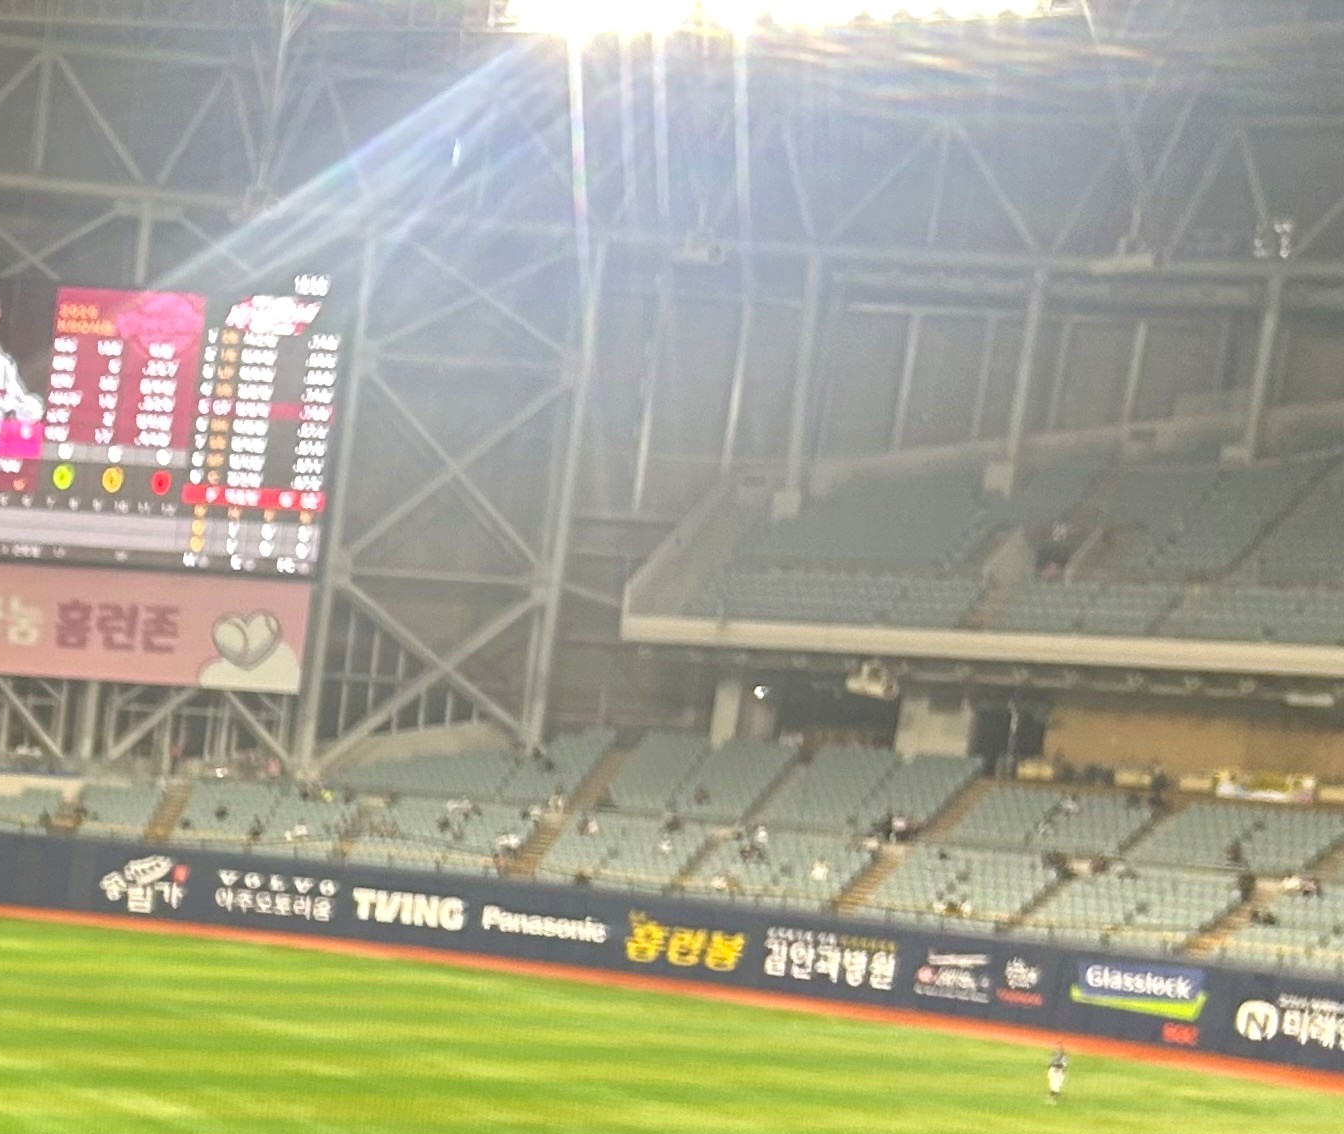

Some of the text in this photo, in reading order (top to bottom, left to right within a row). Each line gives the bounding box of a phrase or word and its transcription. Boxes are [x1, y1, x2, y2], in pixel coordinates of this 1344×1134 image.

[55, 598, 179, 654] 홈런존
[353, 887, 466, 931] TVING
[481, 905, 608, 944] Panasonic
[1085, 964, 1192, 999] Glasslock
